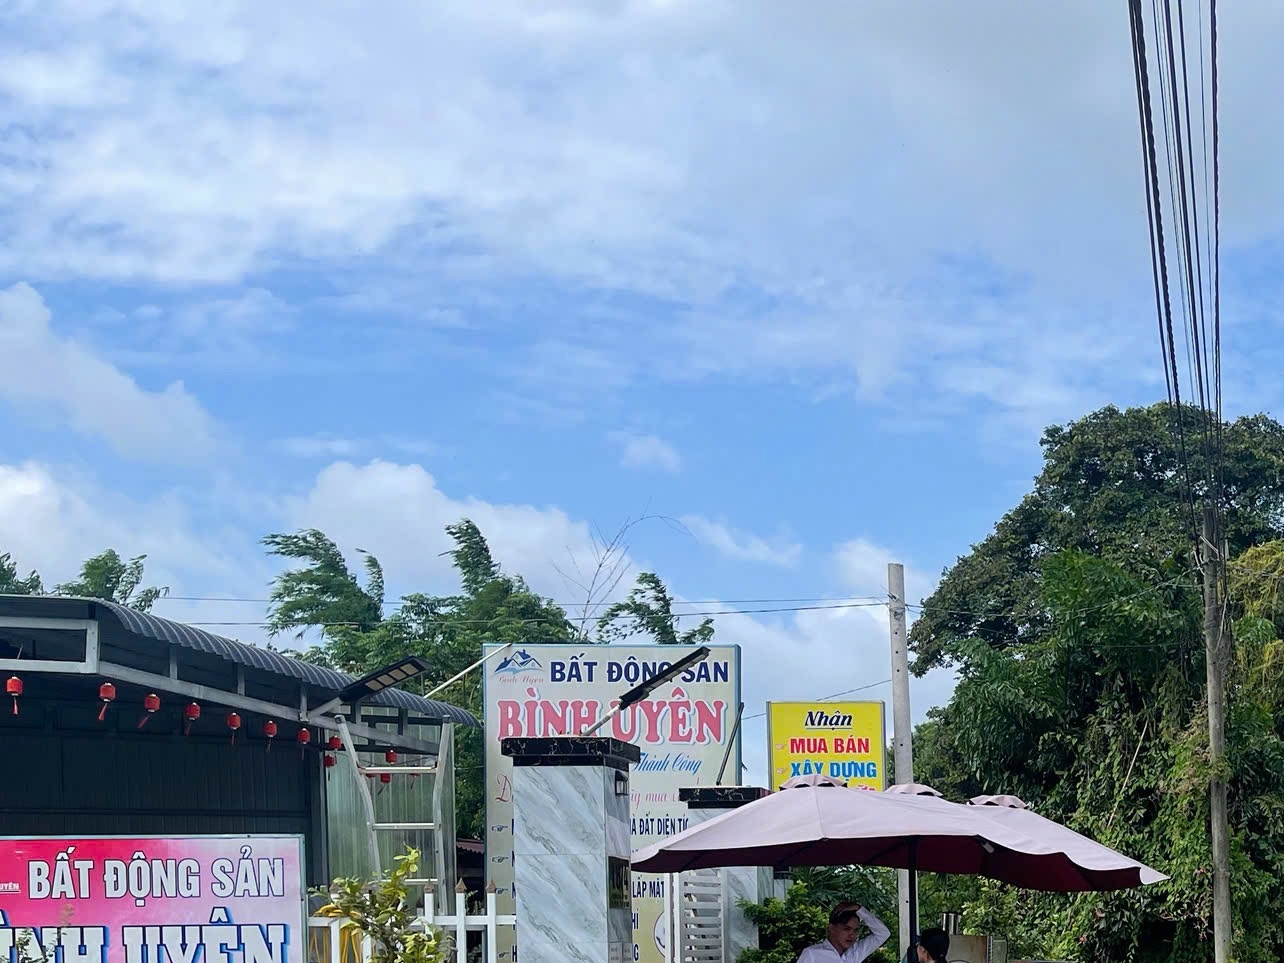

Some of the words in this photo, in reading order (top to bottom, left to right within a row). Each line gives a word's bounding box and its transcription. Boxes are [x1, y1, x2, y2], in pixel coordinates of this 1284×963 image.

[550, 652, 598, 683] BẤT
[497, 686, 601, 742] BÌNH
[610, 686, 728, 745] UYÊN
[804, 710, 853, 731] Nhận
[790, 738, 828, 754] MUA
[834, 734, 870, 754] BÁN
[791, 759, 824, 778] XÂY
[829, 760, 877, 782] DỰNG
[639, 811, 655, 835] ĐẤT
[657, 813, 676, 839] DIỆN
[28, 846, 94, 900] BẤT
[104, 850, 201, 907] ĐỘNG
[211, 845, 285, 898] SẢN
